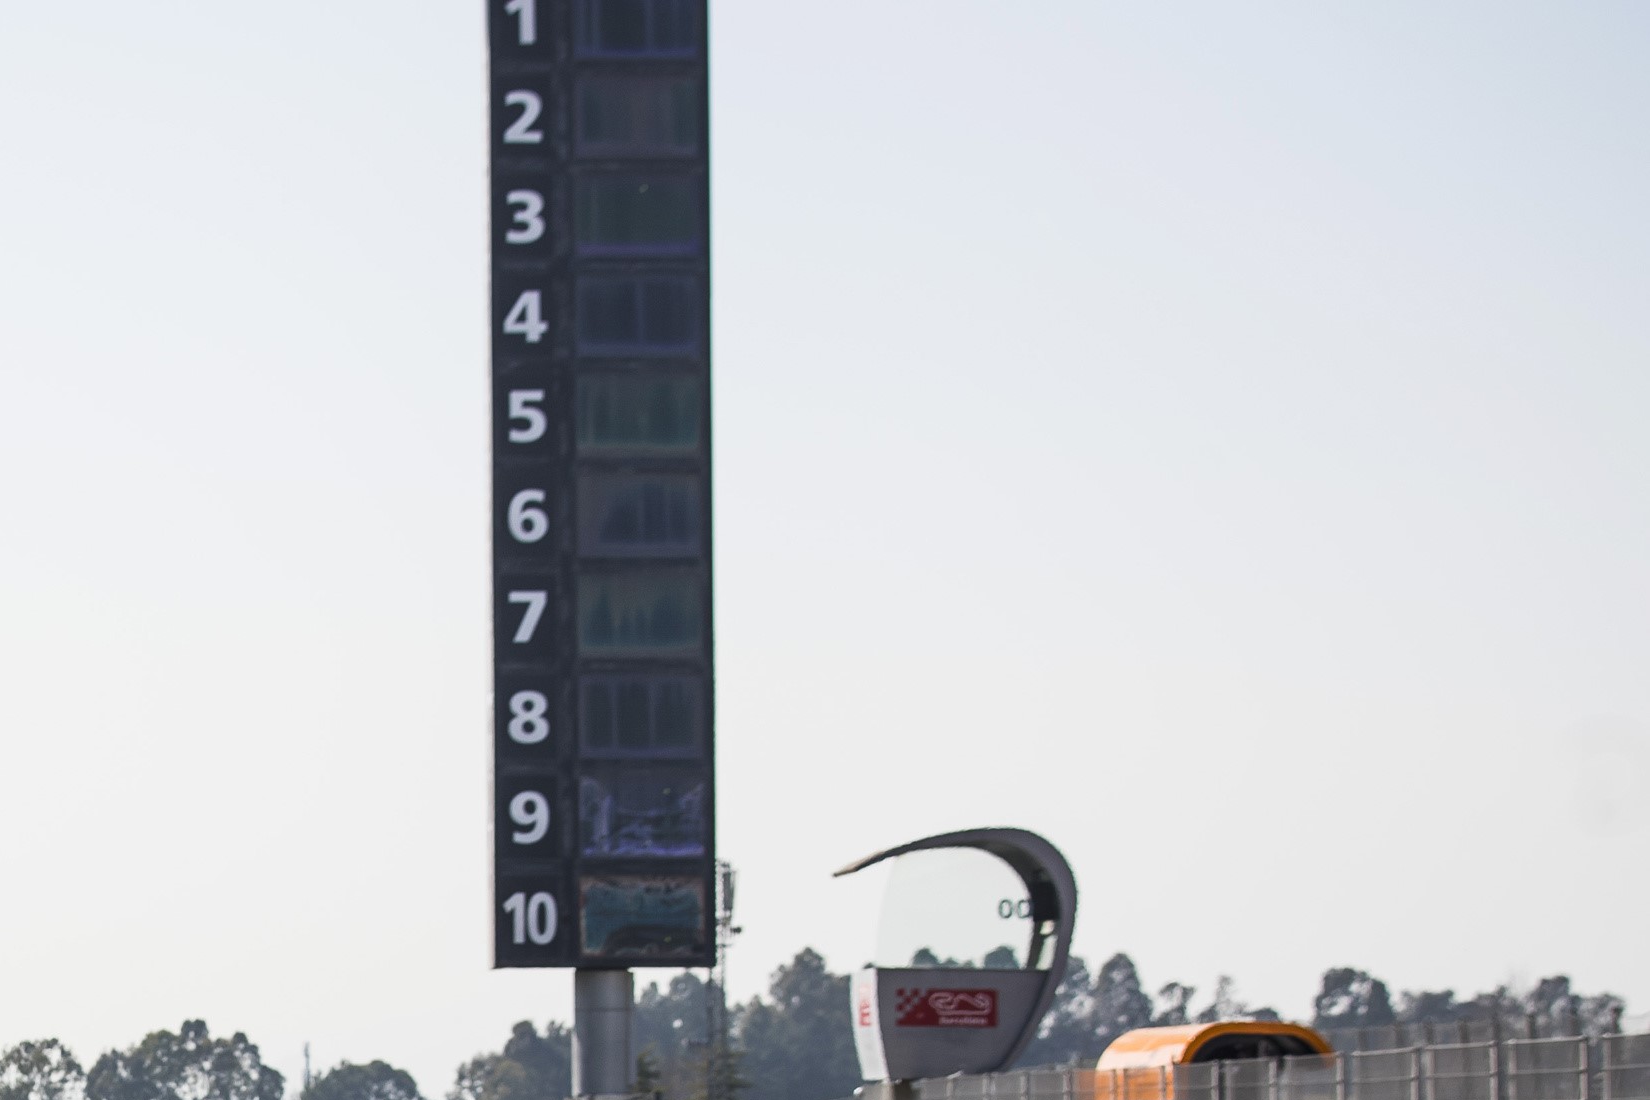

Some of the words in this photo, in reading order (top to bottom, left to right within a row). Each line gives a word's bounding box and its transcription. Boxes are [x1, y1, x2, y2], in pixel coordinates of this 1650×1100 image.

[506, 0, 535, 44] 1
[504, 90, 542, 143] 2
[506, 190, 545, 244] 3
[503, 290, 548, 343] 4
[508, 390, 547, 443] 5
[508, 489, 548, 543] 6
[508, 590, 547, 643] 7
[508, 690, 549, 744] 8
[509, 791, 549, 844] 9
[503, 892, 557, 945] 10
